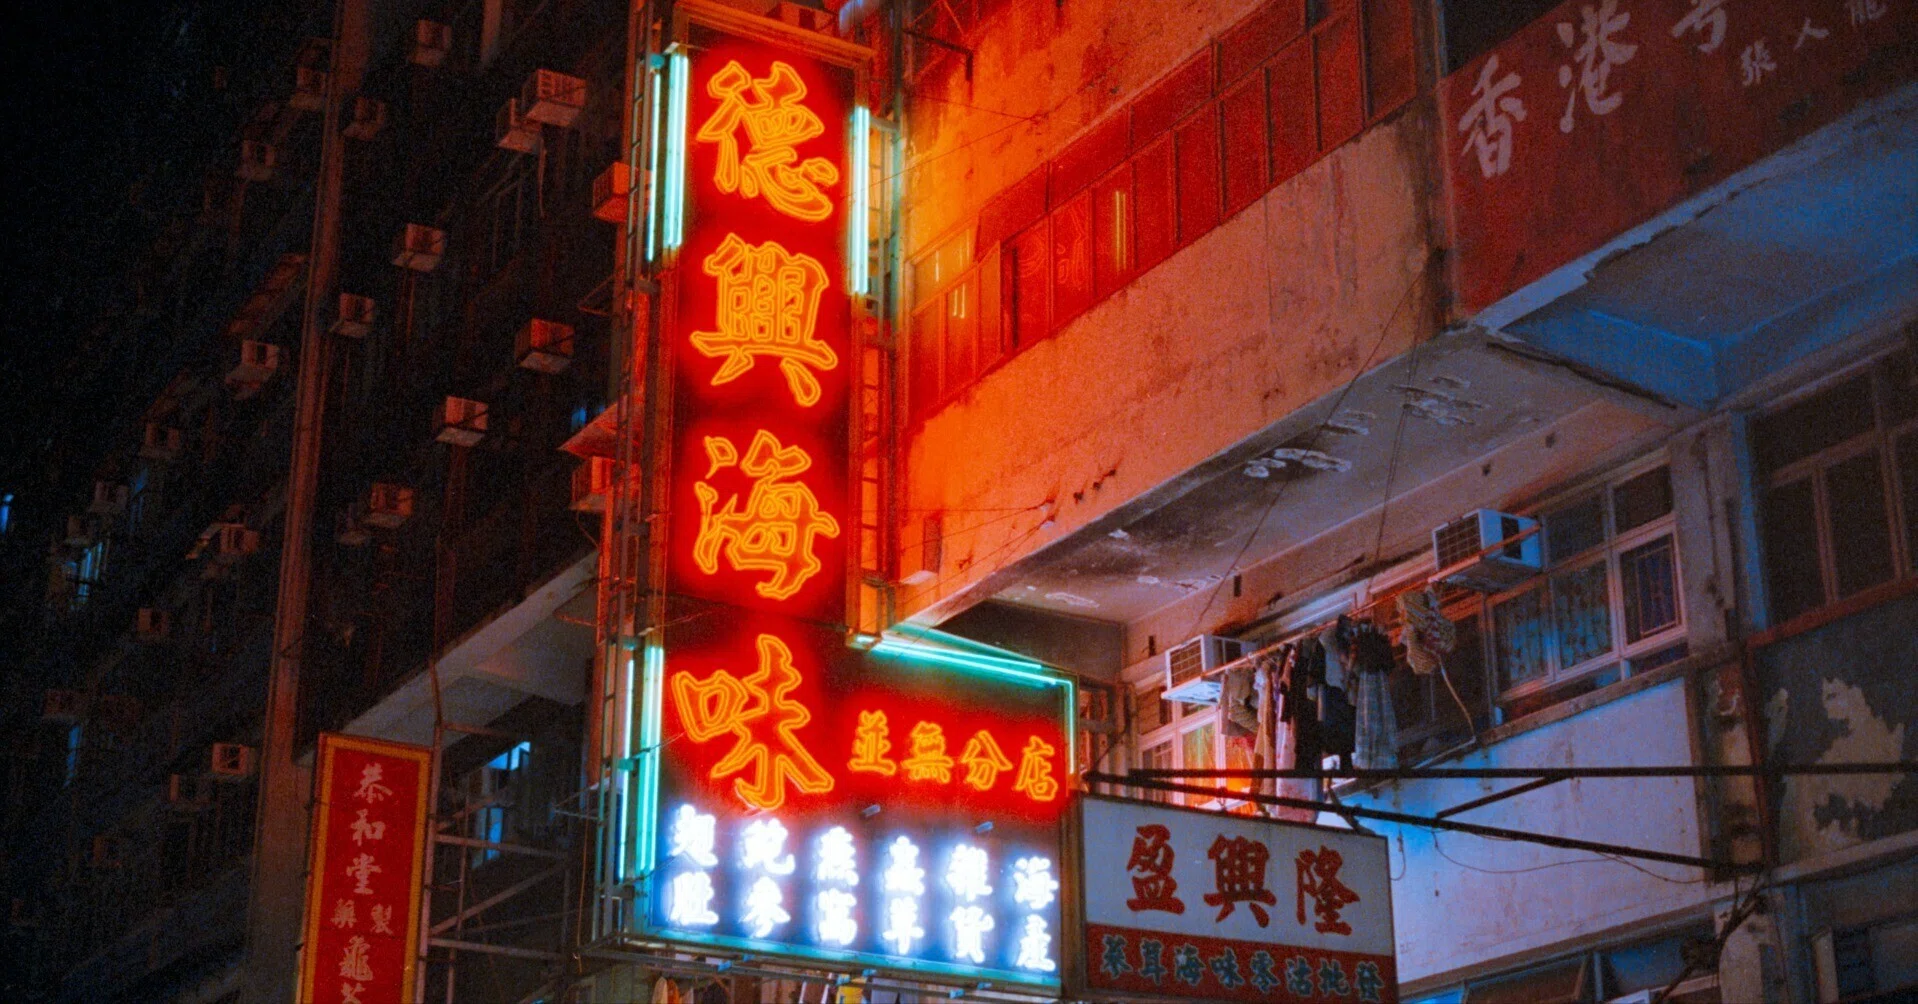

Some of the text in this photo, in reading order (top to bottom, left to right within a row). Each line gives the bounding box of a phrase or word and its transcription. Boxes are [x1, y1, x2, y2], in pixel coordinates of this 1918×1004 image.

[670, 59, 842, 811] 德興海味
[847, 708, 1060, 803] 並無分店
[346, 762, 393, 896] 恭和堂
[1126, 823, 1361, 936] 盈興隆
